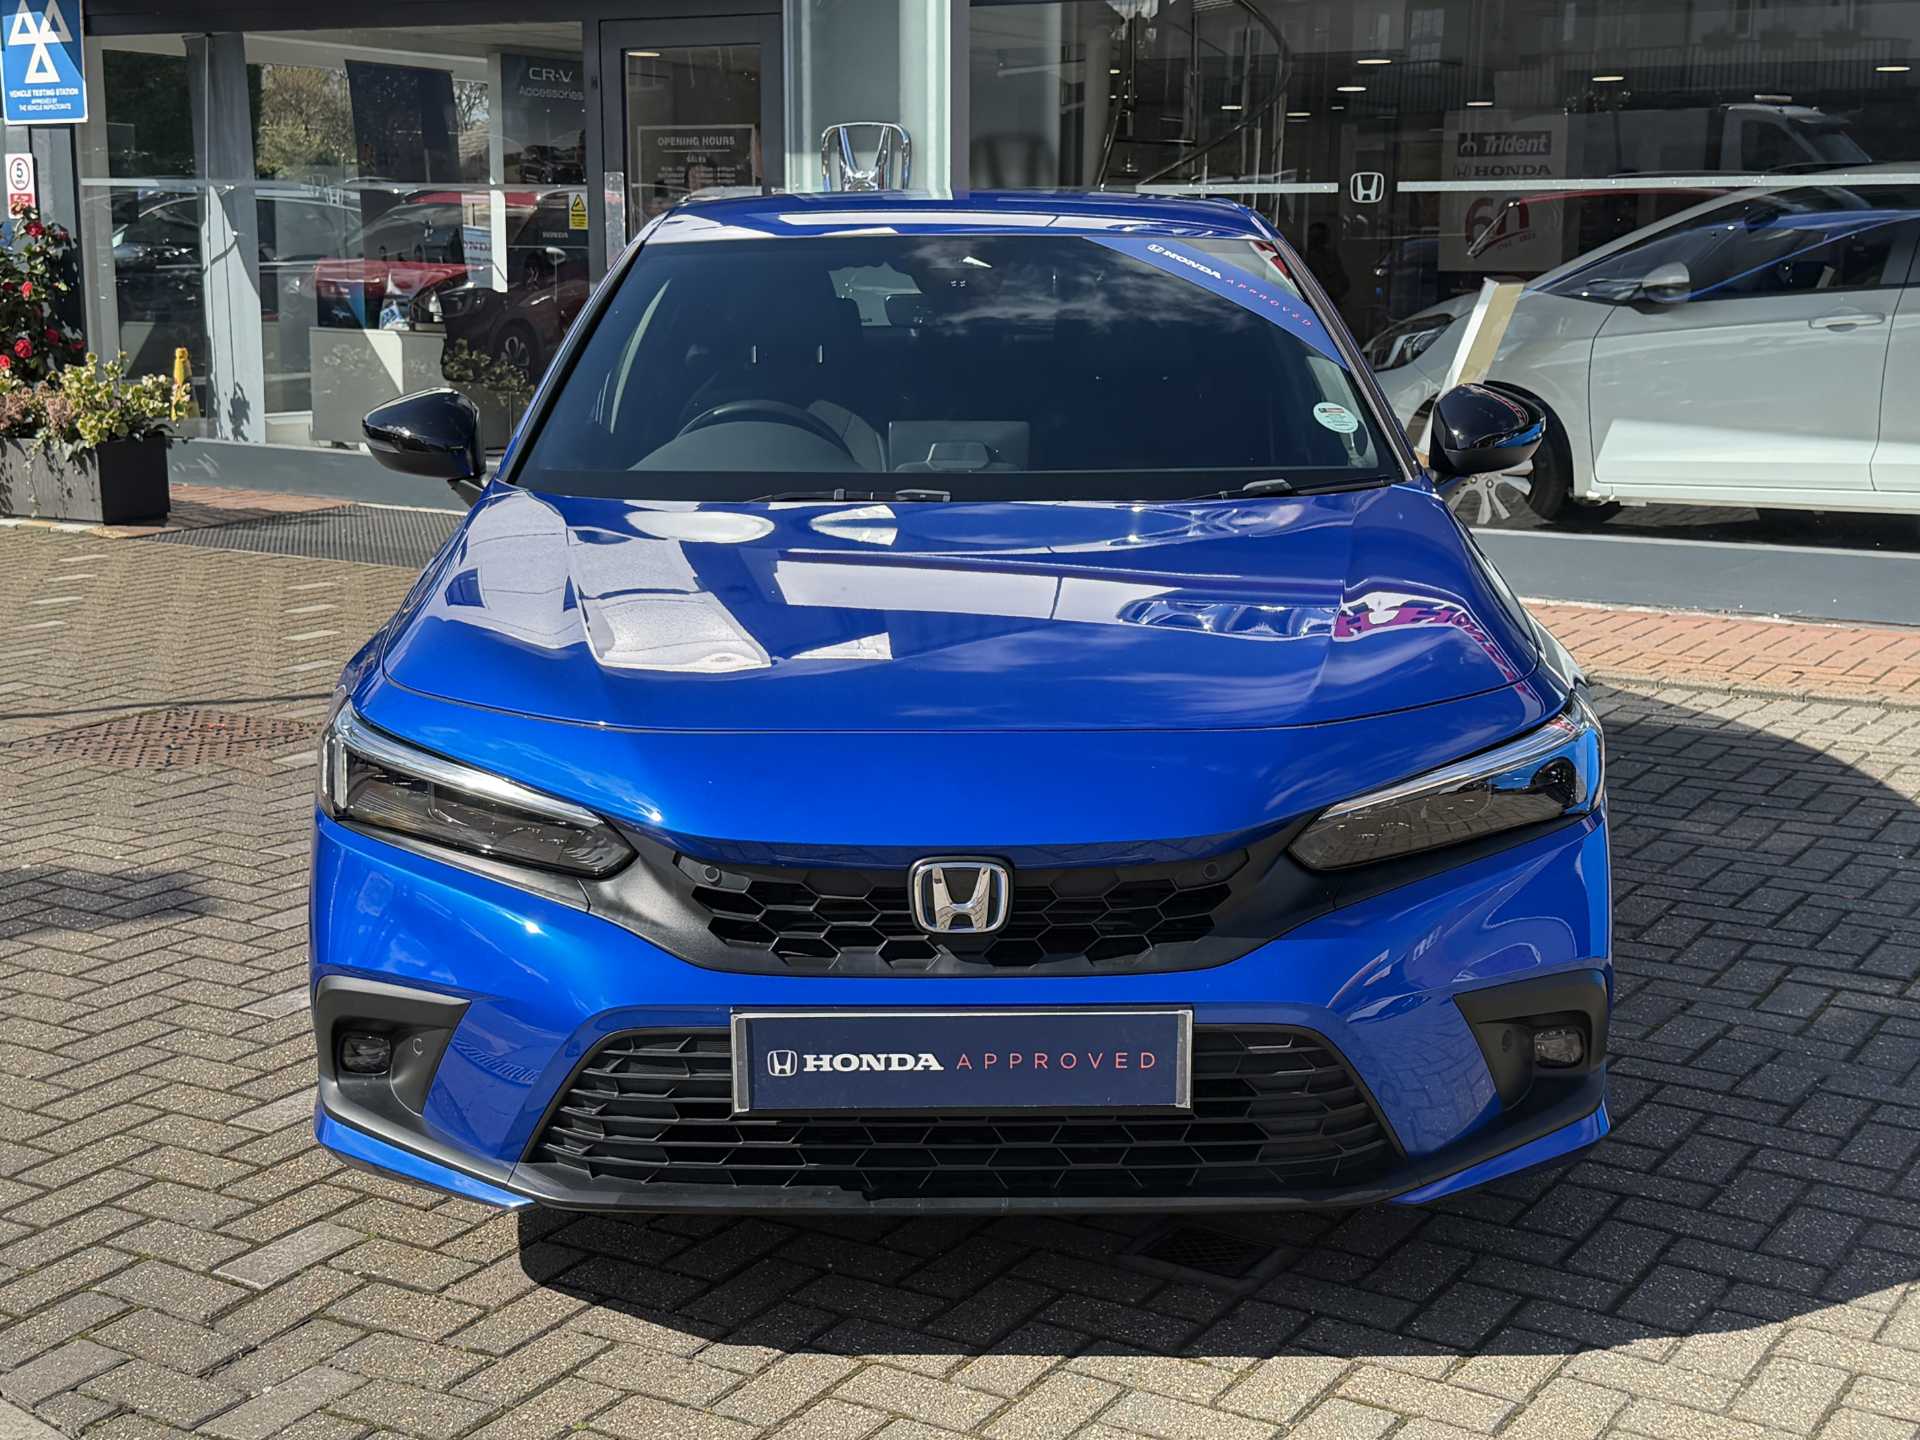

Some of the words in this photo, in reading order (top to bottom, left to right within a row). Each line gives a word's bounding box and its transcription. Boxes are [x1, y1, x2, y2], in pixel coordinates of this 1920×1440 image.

[657, 136, 700, 146] OPENING
[702, 136, 736, 146] HOURS
[1482, 134, 1547, 154] Trident
[16, 162, 24, 178] 5
[1474, 164, 1552, 176] HONDA
[1163, 250, 1221, 279] HONDA
[1225, 278, 1312, 327] APPROVED
[803, 1053, 945, 1072] HONDA
[956, 1052, 1156, 1070] APPROVED
